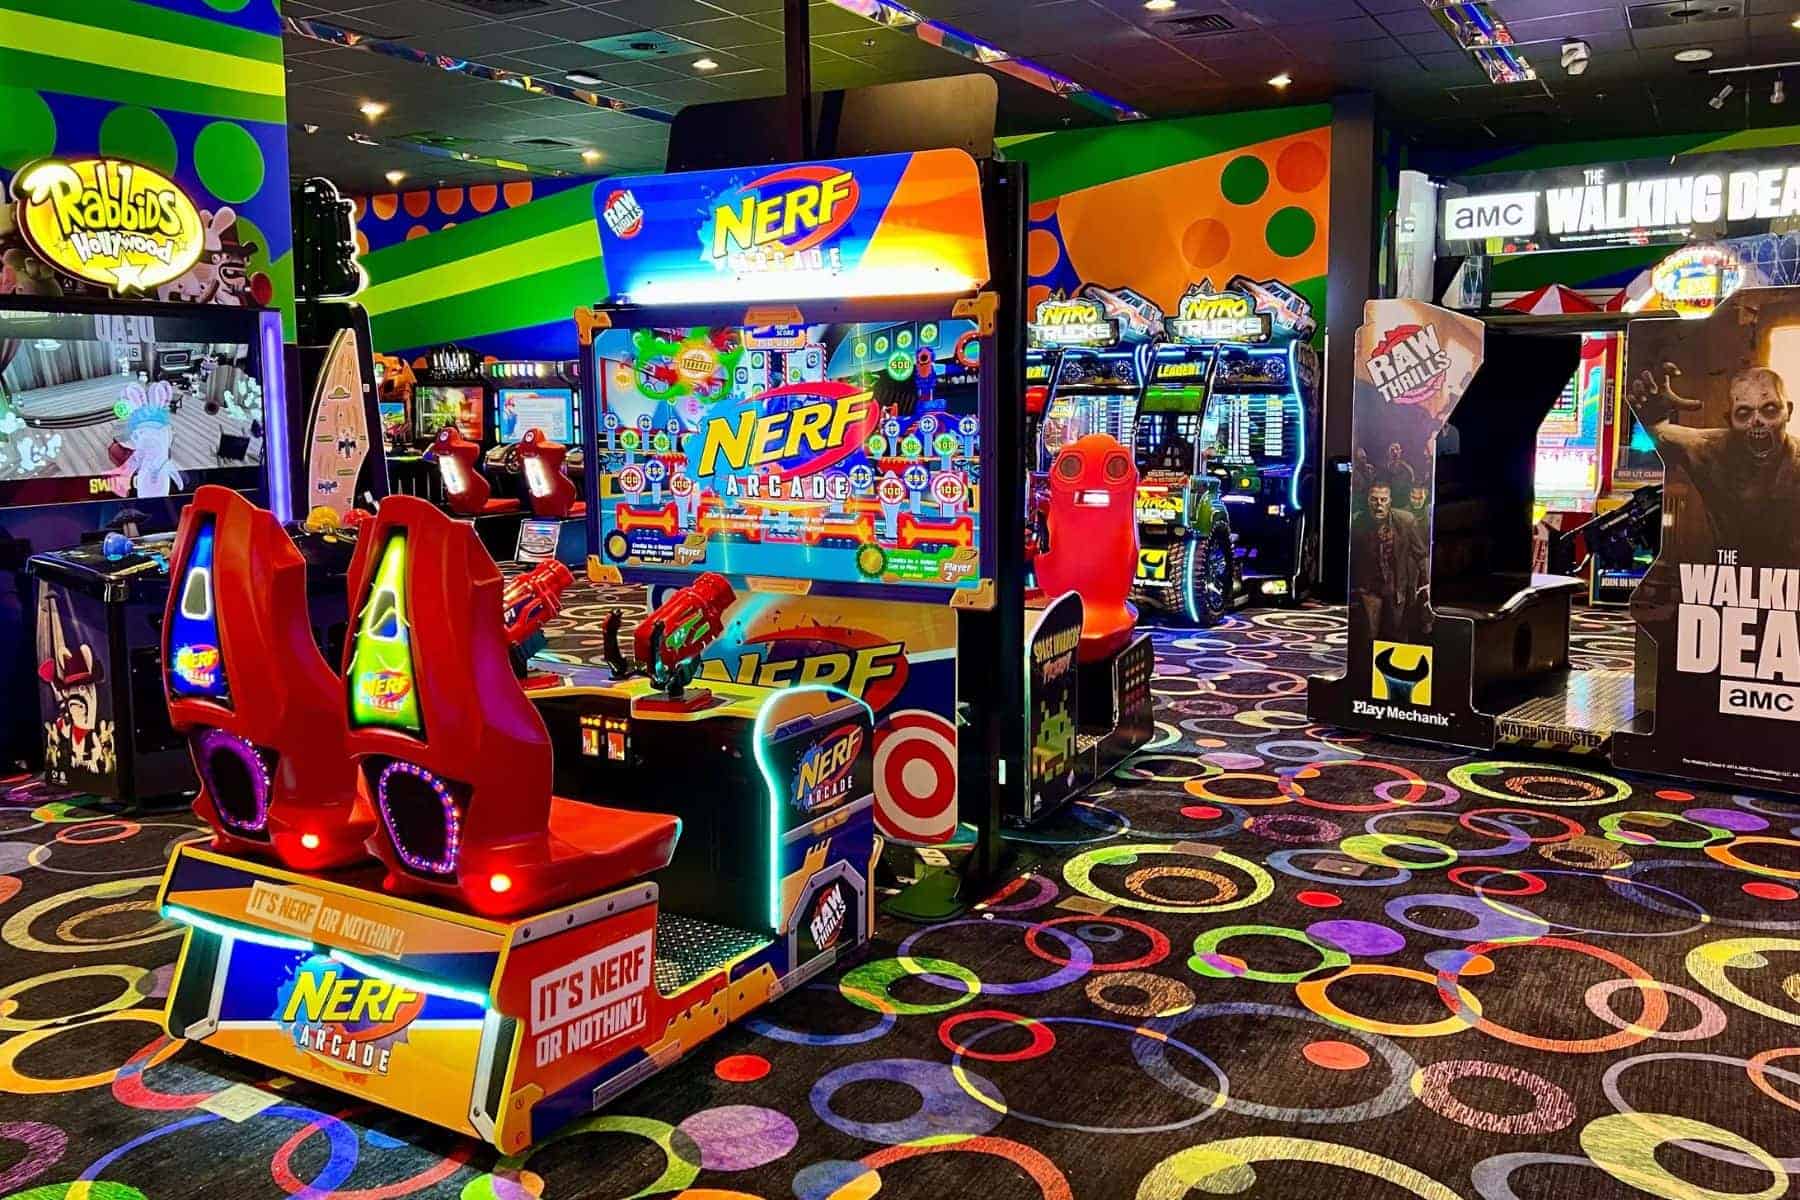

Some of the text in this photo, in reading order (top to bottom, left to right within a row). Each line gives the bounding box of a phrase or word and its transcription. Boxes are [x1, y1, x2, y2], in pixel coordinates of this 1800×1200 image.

[1584, 168, 1605, 186] THE
[603, 190, 637, 228] RAW
[711, 170, 853, 259] NERF
[1546, 172, 1722, 235] WALKING
[1726, 166, 1800, 221] DEA
[70, 230, 175, 264] Hollywood
[1044, 305, 1098, 325] NITRO
[1172, 317, 1262, 339] TRUCKS
[1186, 298, 1248, 320] NITRO
[1031, 323, 1111, 341] TRUCKS
[1366, 324, 1440, 389] RAW
[1378, 349, 1452, 403] THRILLS
[698, 391, 874, 477] NERF
[726, 473, 849, 500] ARCADE
[1136, 508, 1176, 520] RUCKS
[943, 562, 972, 572] Player
[1717, 549, 1738, 565] THE
[1679, 563, 1800, 611] WALKI
[1676, 603, 1800, 683] DEA
[701, 642, 905, 699] NERF
[1352, 701, 1449, 726] Play Mechanix
[1501, 722, 1602, 747] WATCH YOUR STEP
[796, 726, 862, 800] NERF
[805, 775, 852, 810] ARCADE
[251, 888, 279, 914] IT'S
[280, 895, 317, 923] NERF
[318, 906, 342, 933] OR
[810, 882, 842, 943] RAW
[283, 971, 417, 1022] NERF
[539, 945, 645, 1022] IT'S NERF
[298, 1023, 391, 1074] ARCADE
[536, 1029, 562, 1068] OR
